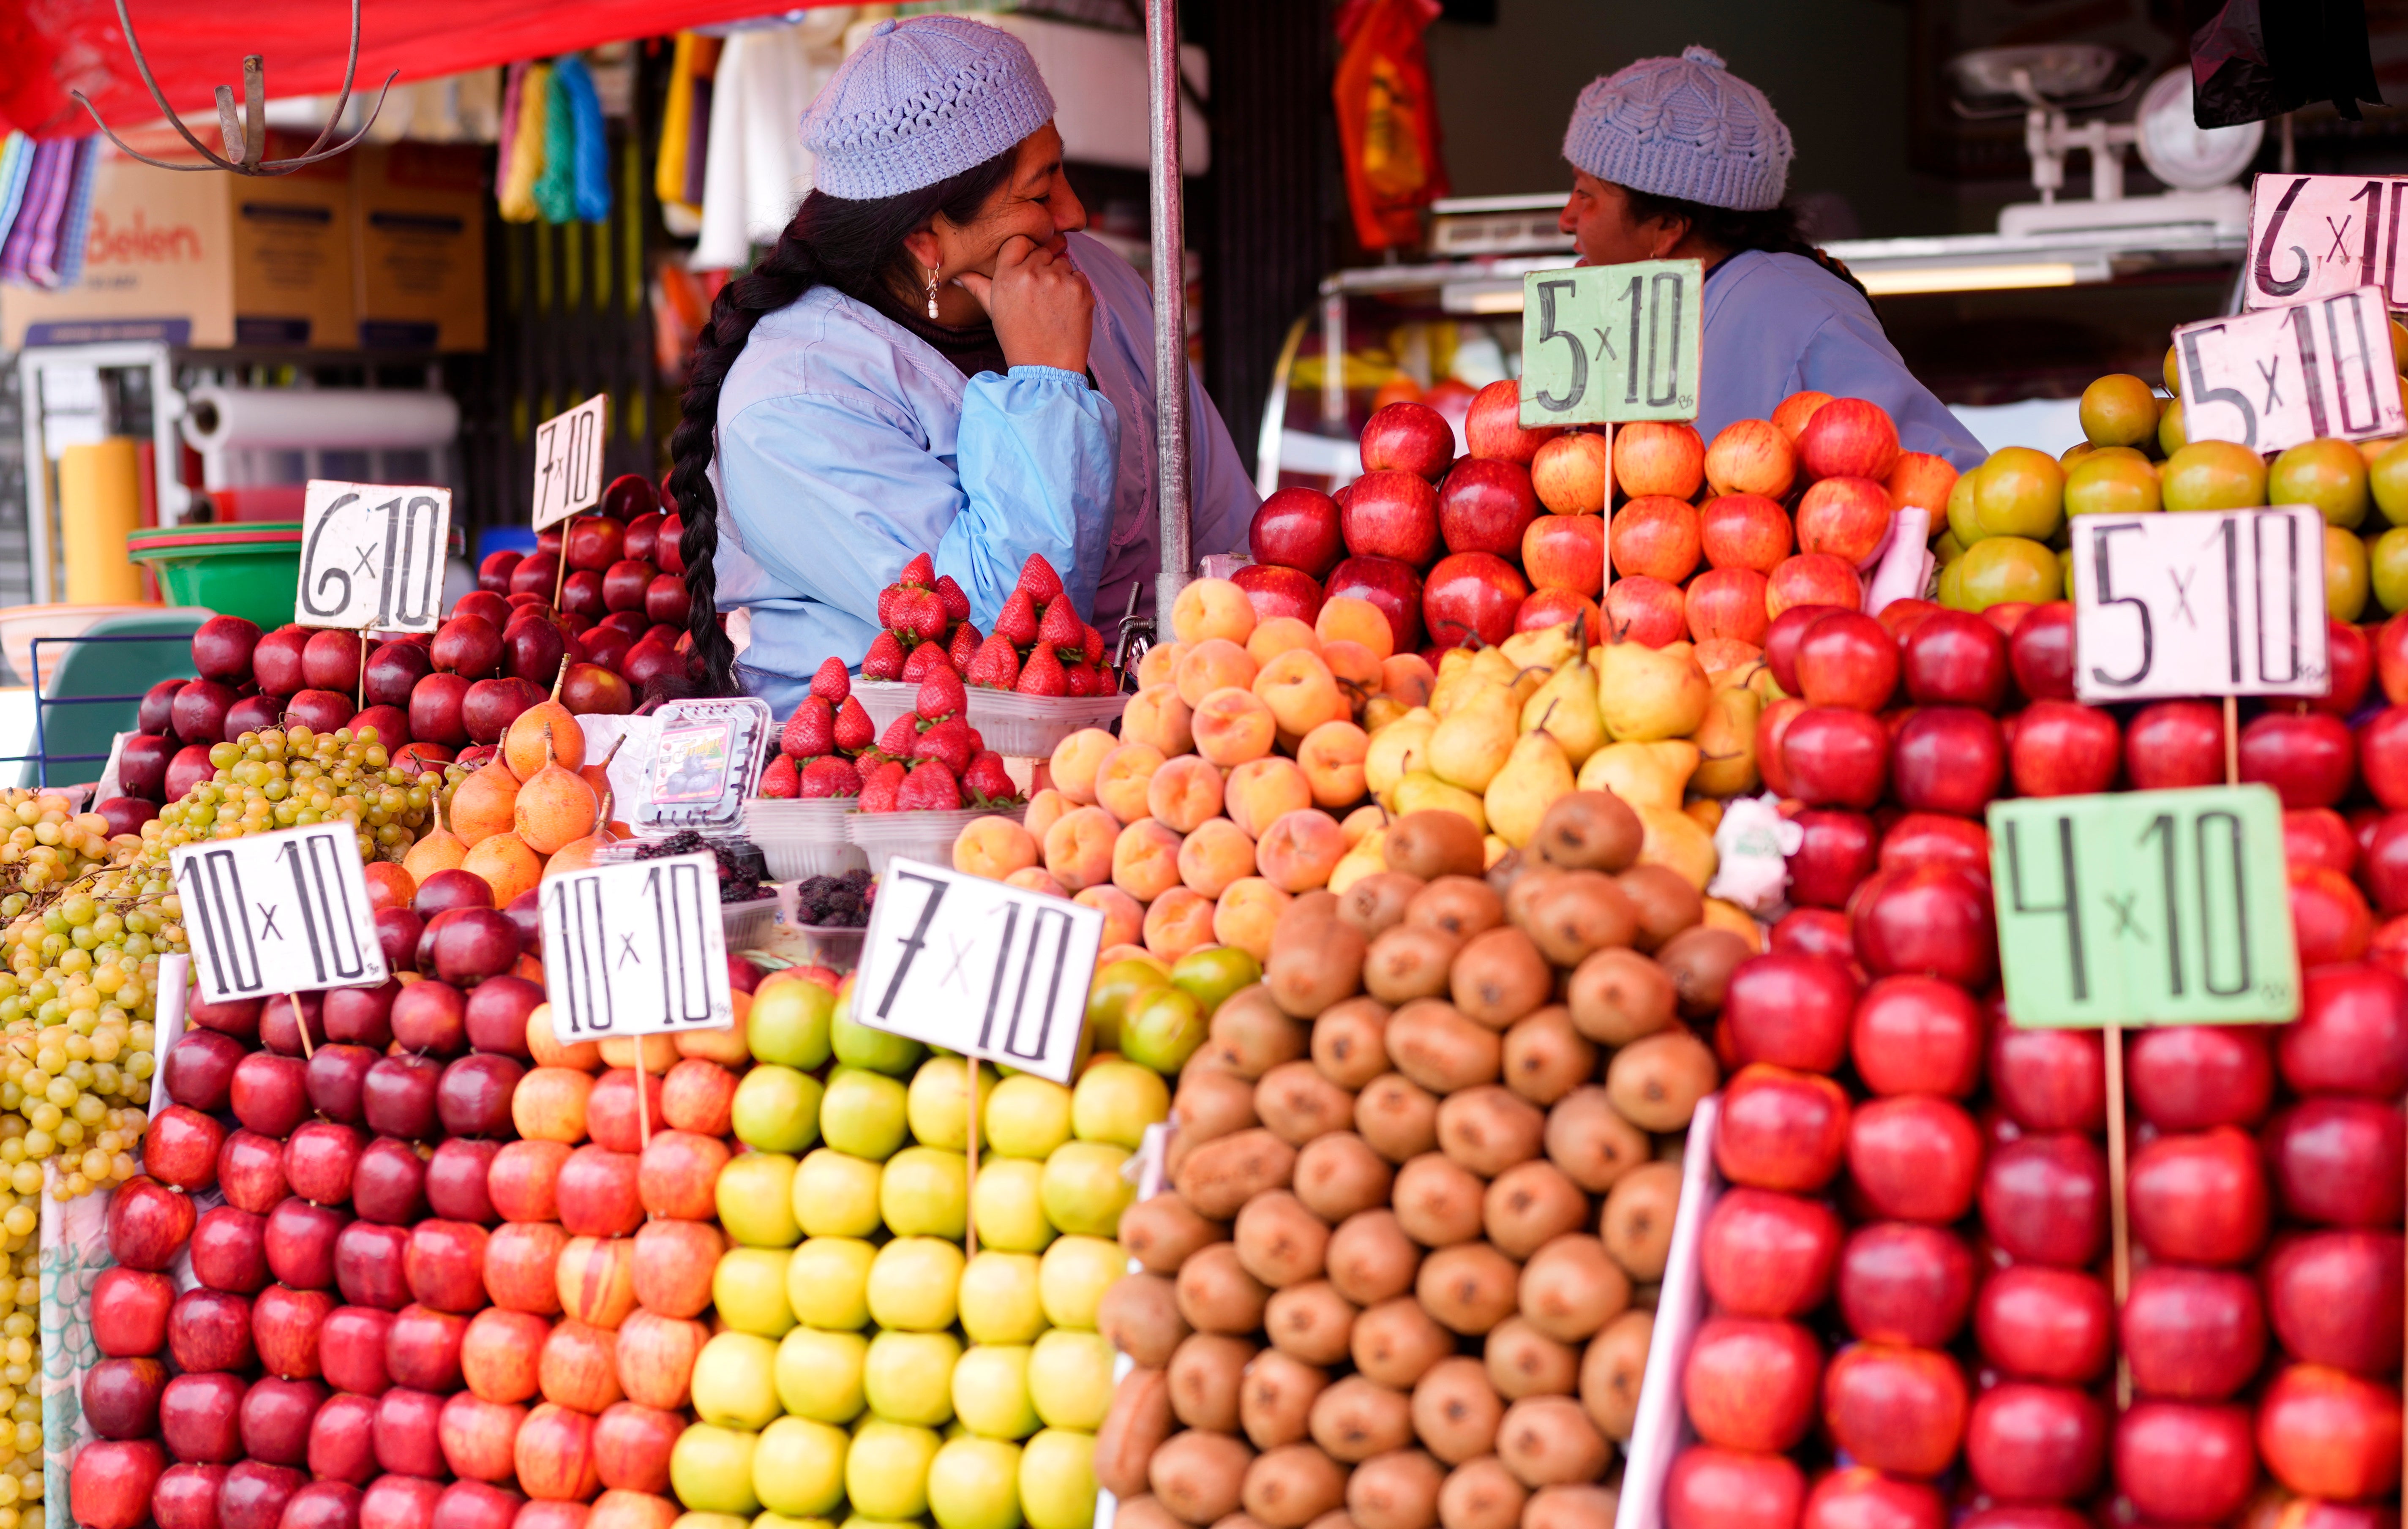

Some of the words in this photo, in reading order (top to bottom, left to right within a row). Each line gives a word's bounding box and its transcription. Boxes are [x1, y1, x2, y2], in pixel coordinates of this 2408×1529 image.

[2255, 178, 2312, 297] 6
[1536, 279, 1588, 412] 5
[1594, 327, 1617, 361] x
[1618, 272, 1684, 407] 10
[2181, 324, 2257, 449] 5
[2280, 293, 2382, 438] 10
[540, 423, 557, 521] 7
[565, 411, 594, 509] 10
[302, 493, 360, 616] 6
[353, 542, 378, 578] x
[375, 496, 440, 626] 10
[2092, 522, 2152, 687] 5
[2202, 515, 2298, 683] 10
[177, 849, 263, 995] 10
[256, 902, 284, 940] x
[275, 835, 364, 983] 10
[542, 876, 612, 1033] 10
[619, 932, 641, 970] x
[642, 864, 711, 1024] 10
[876, 870, 951, 1019] 7
[987, 901, 1074, 1060] 10
[2005, 817, 2087, 1000] 4
[2138, 812, 2250, 996] 10
